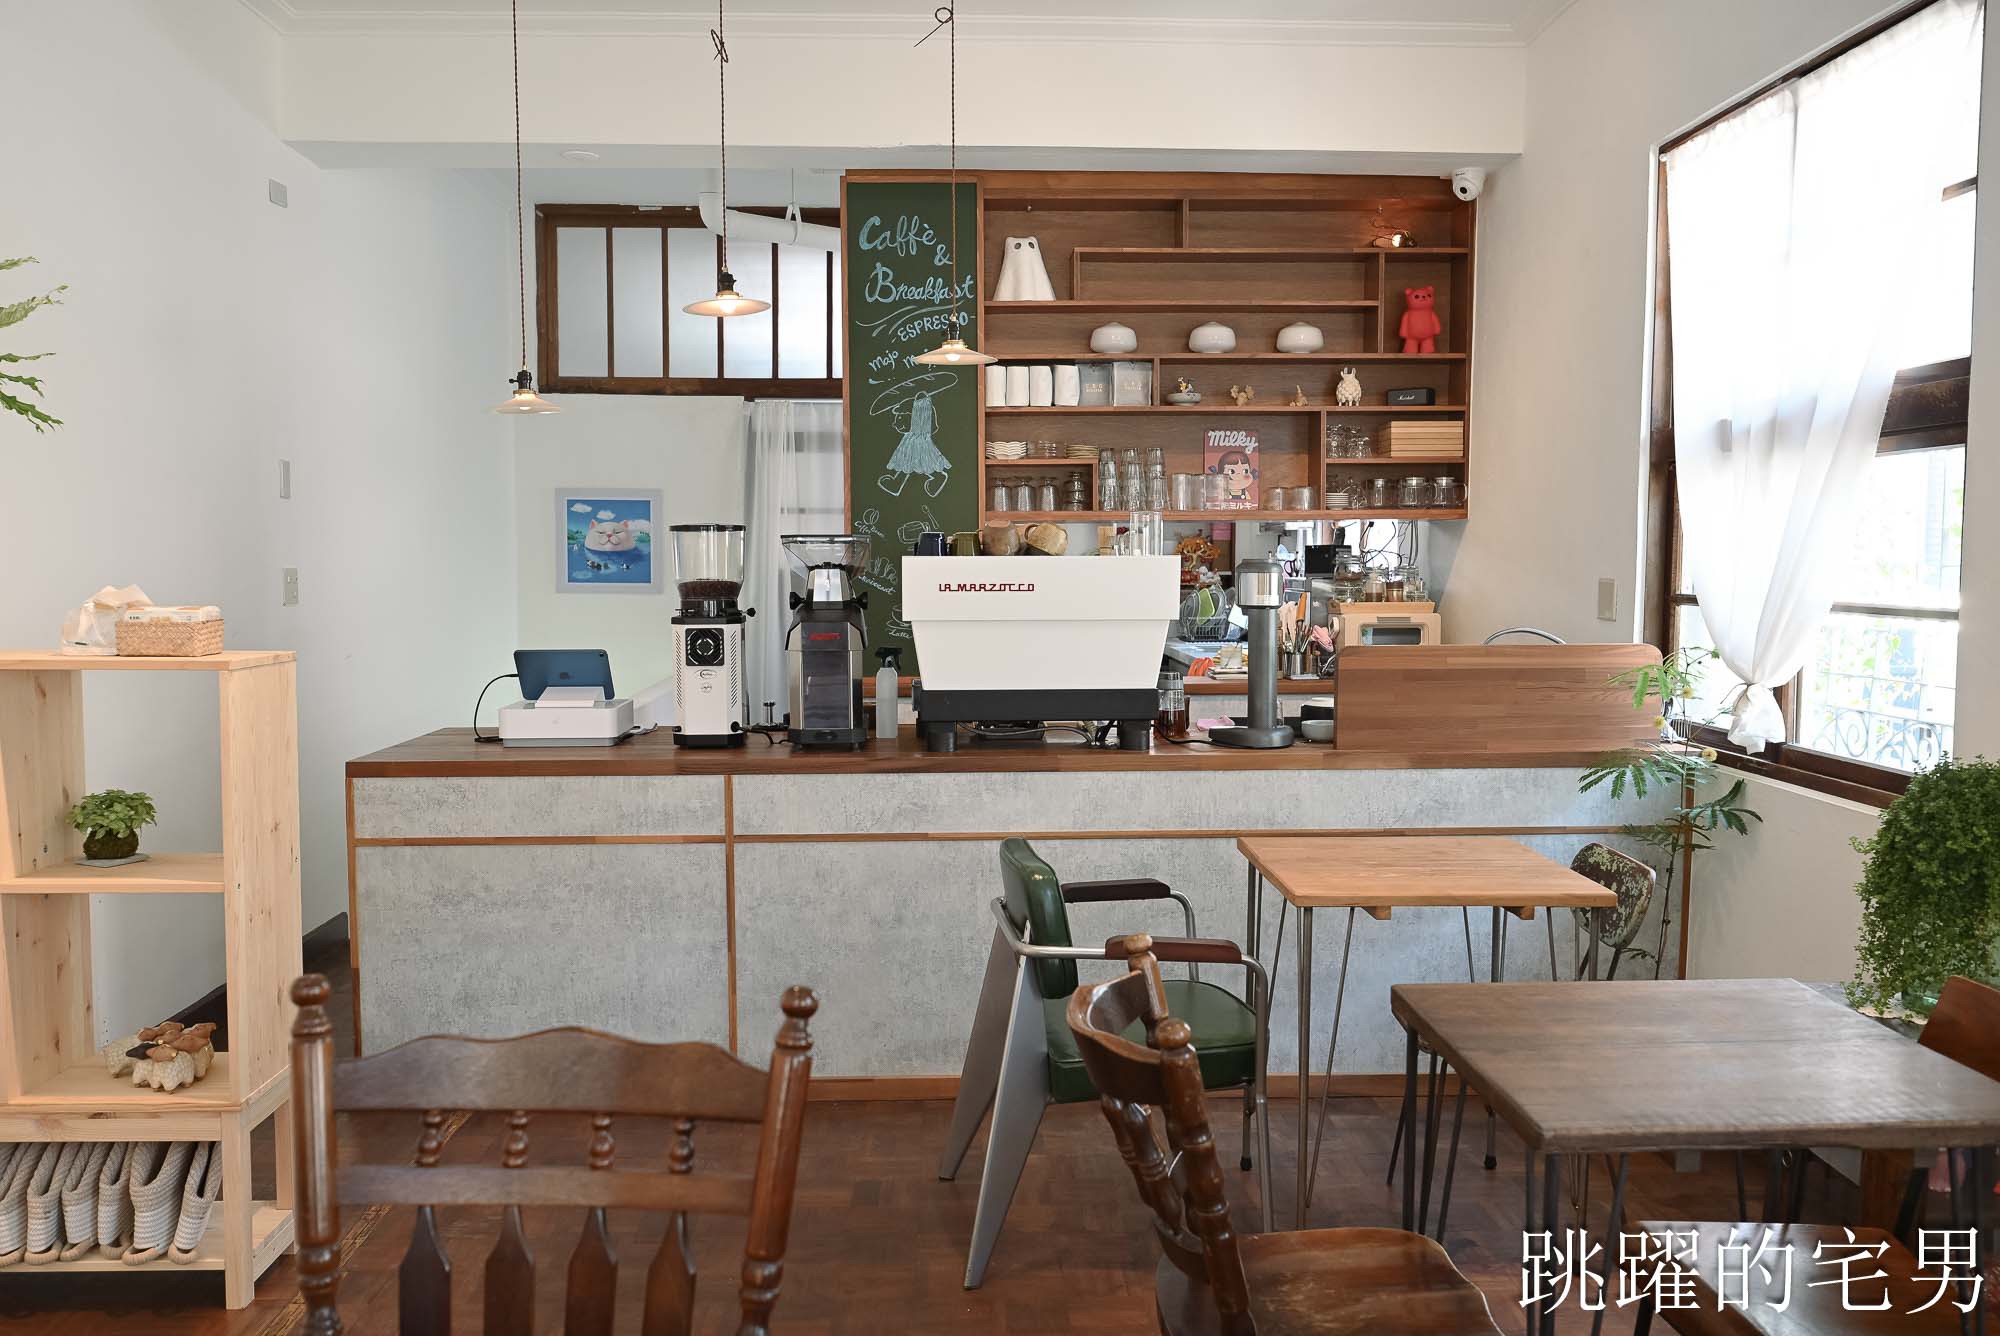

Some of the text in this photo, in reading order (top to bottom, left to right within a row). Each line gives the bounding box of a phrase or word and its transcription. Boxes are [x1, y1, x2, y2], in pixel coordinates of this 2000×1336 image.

[859, 216, 937, 257] Caffè
[934, 244, 954, 266] &
[865, 262, 975, 305] Breakfast
[897, 311, 968, 342] ESPRESO
[1208, 430, 1259, 454] Milky
[858, 575, 897, 595] roissant
[939, 583, 951, 592] LA
[888, 628, 913, 640] Latte
